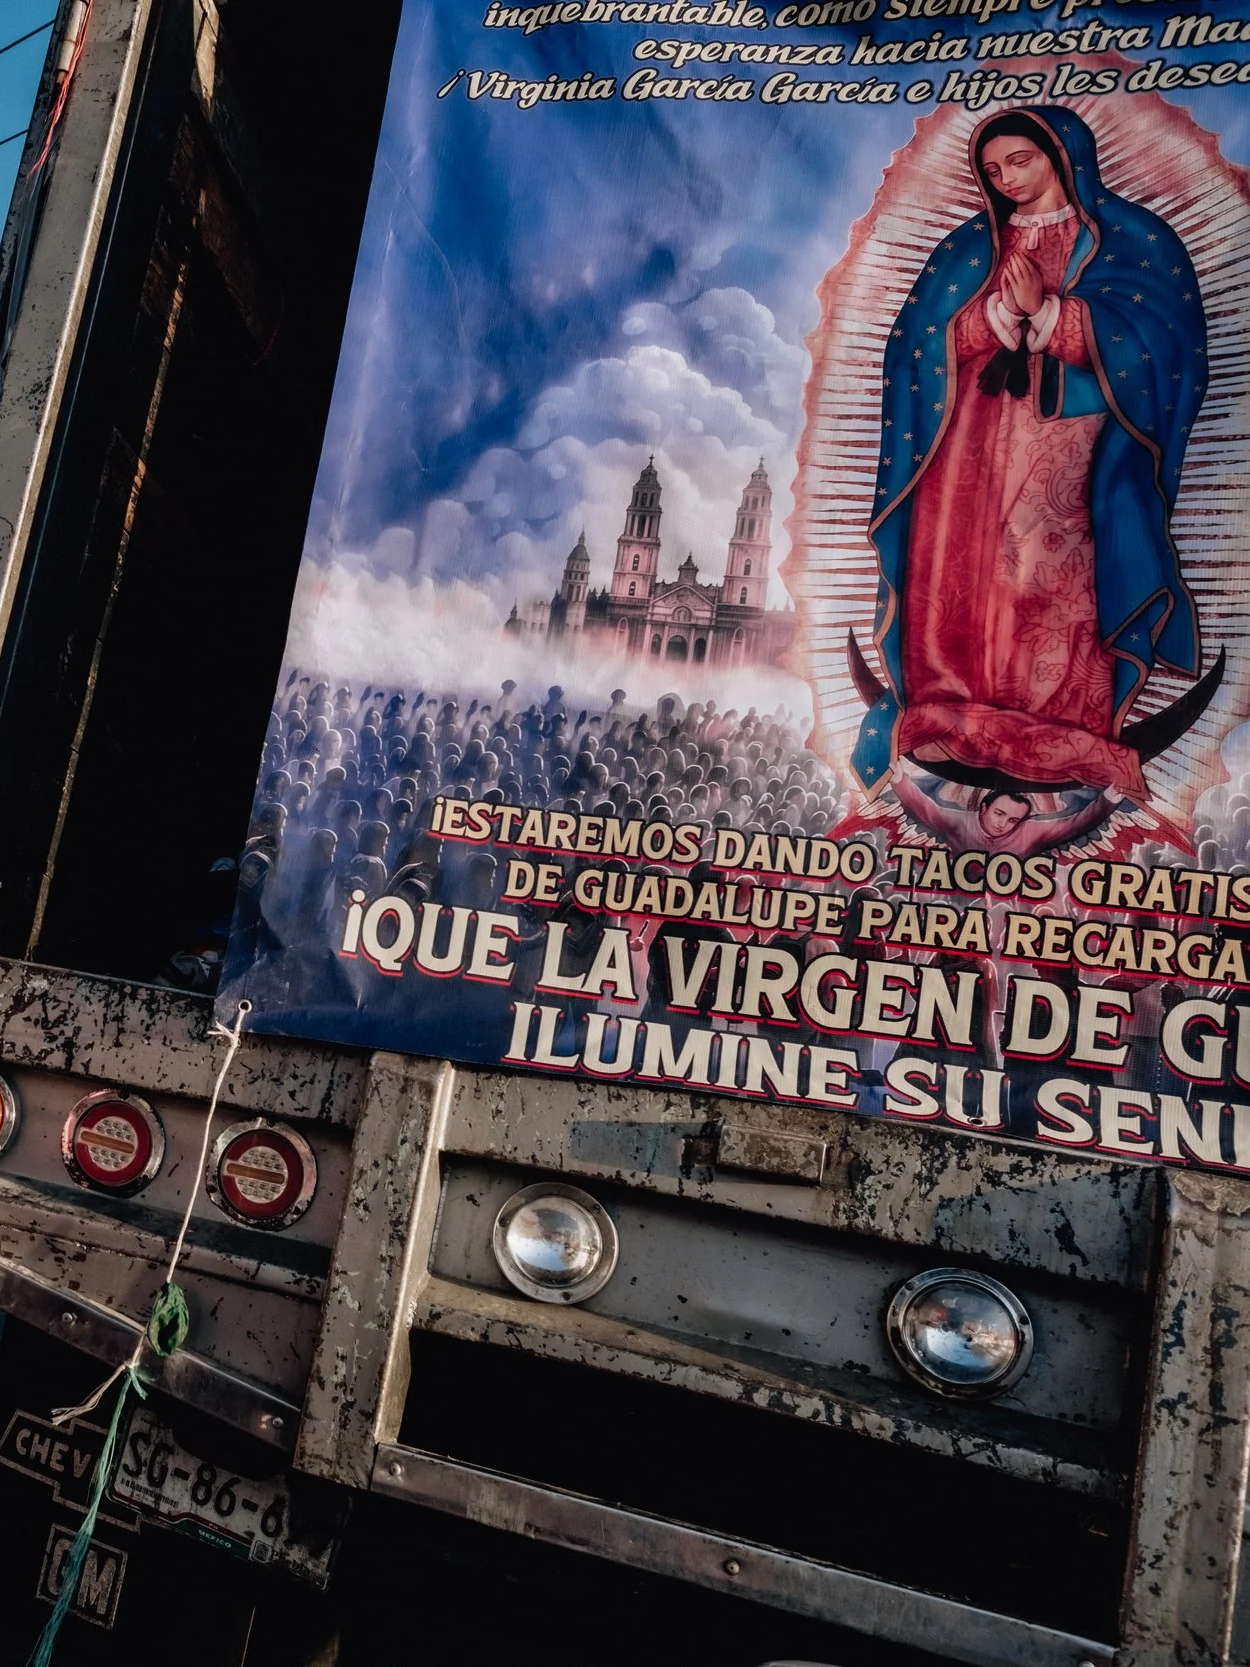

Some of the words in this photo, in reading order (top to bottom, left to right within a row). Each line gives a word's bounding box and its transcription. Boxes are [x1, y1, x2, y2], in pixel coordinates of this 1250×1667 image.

[484, 0, 767, 34] inquebrantable,
[775, 0, 876, 27] como
[635, 40, 842, 68] esperanza
[851, 32, 967, 64] hacia
[976, 21, 1150, 58] nuestra
[622, 69, 753, 101] García
[761, 72, 897, 103] García
[906, 81, 931, 102] e
[939, 72, 1043, 110] hijos
[1051, 64, 1118, 97] les
[431, 797, 702, 862] ¡ESTAREMOS
[713, 830, 875, 883] DANDO
[891, 846, 1055, 899] TACOS
[1070, 860, 1250, 921] GRATIS
[505, 860, 565, 902] DE
[575, 869, 847, 935] GUADALUPE
[859, 900, 989, 953] PARA
[342, 889, 520, 981] ¡QUE
[537, 920, 638, 1000] LA
[663, 936, 981, 1047] VIRGEN
[1006, 977, 1133, 1066] DE
[505, 1001, 859, 1106] ILUMINE
[885, 1057, 1007, 1129] SU
[15, 1427, 97, 1482] CHEV
[198, 1528, 232, 1549] MEXICO
